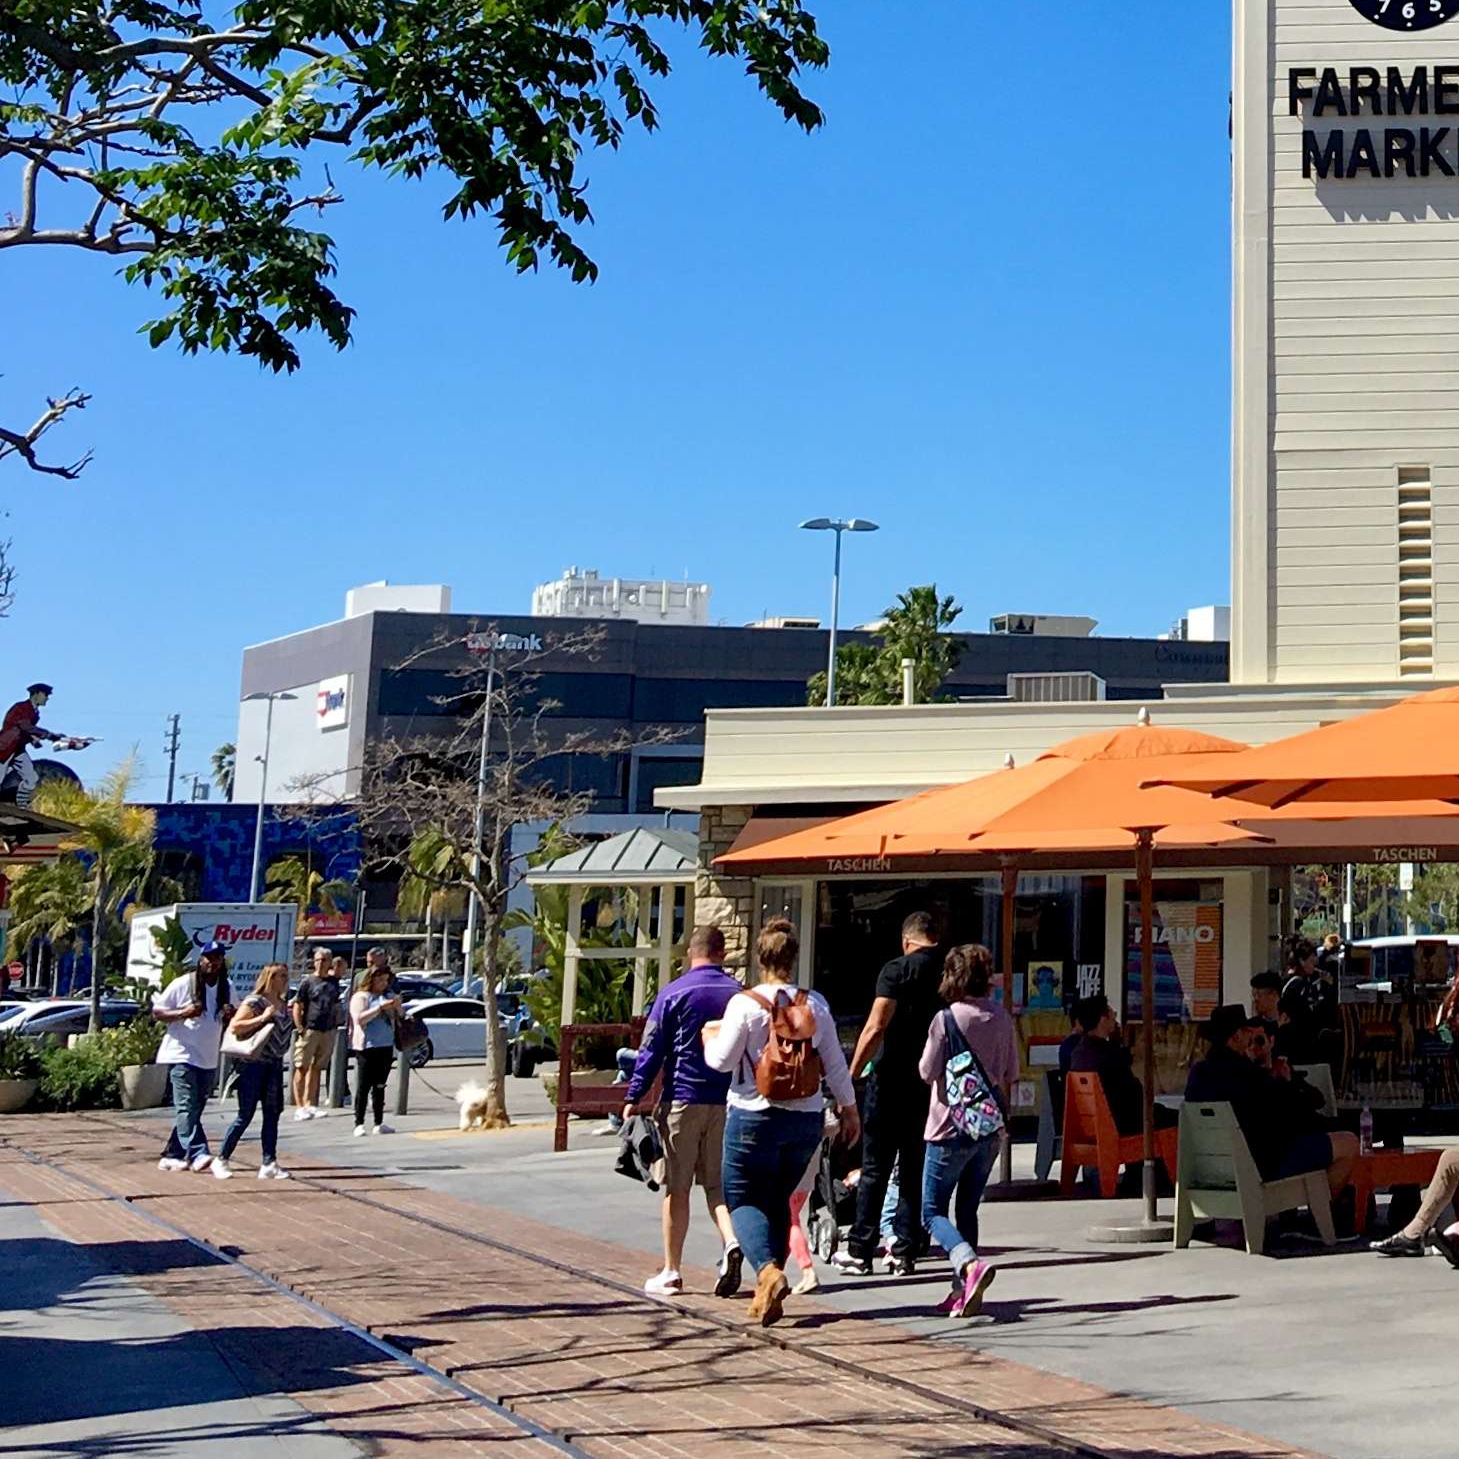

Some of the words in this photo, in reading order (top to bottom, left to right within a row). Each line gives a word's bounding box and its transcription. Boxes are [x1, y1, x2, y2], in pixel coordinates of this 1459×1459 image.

[1401, 2, 1415, 19] 6
[1373, 848, 1437, 860] TASCHEN
[826, 858, 891, 871] TASCHEN
[214, 924, 276, 944] Ryder
[1076, 964, 1101, 988] JAZZ
